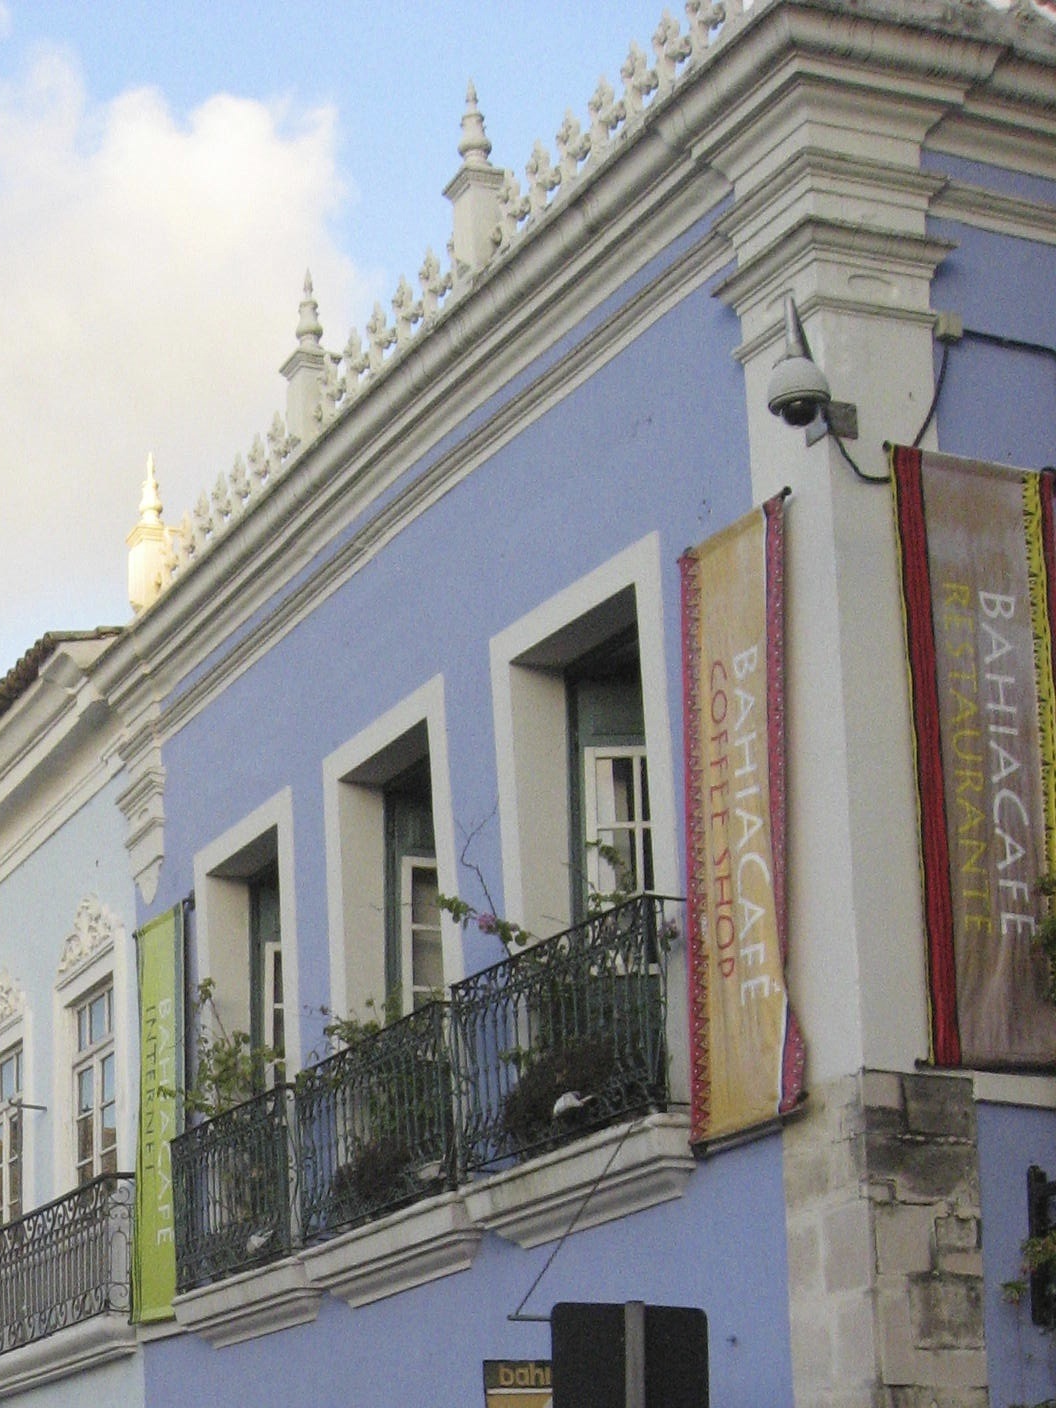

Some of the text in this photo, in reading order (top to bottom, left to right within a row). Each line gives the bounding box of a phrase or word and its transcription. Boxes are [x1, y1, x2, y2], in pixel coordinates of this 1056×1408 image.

[710, 660, 735, 977] COFFEE SHOP
[942, 582, 992, 935] RESTAURANTE
